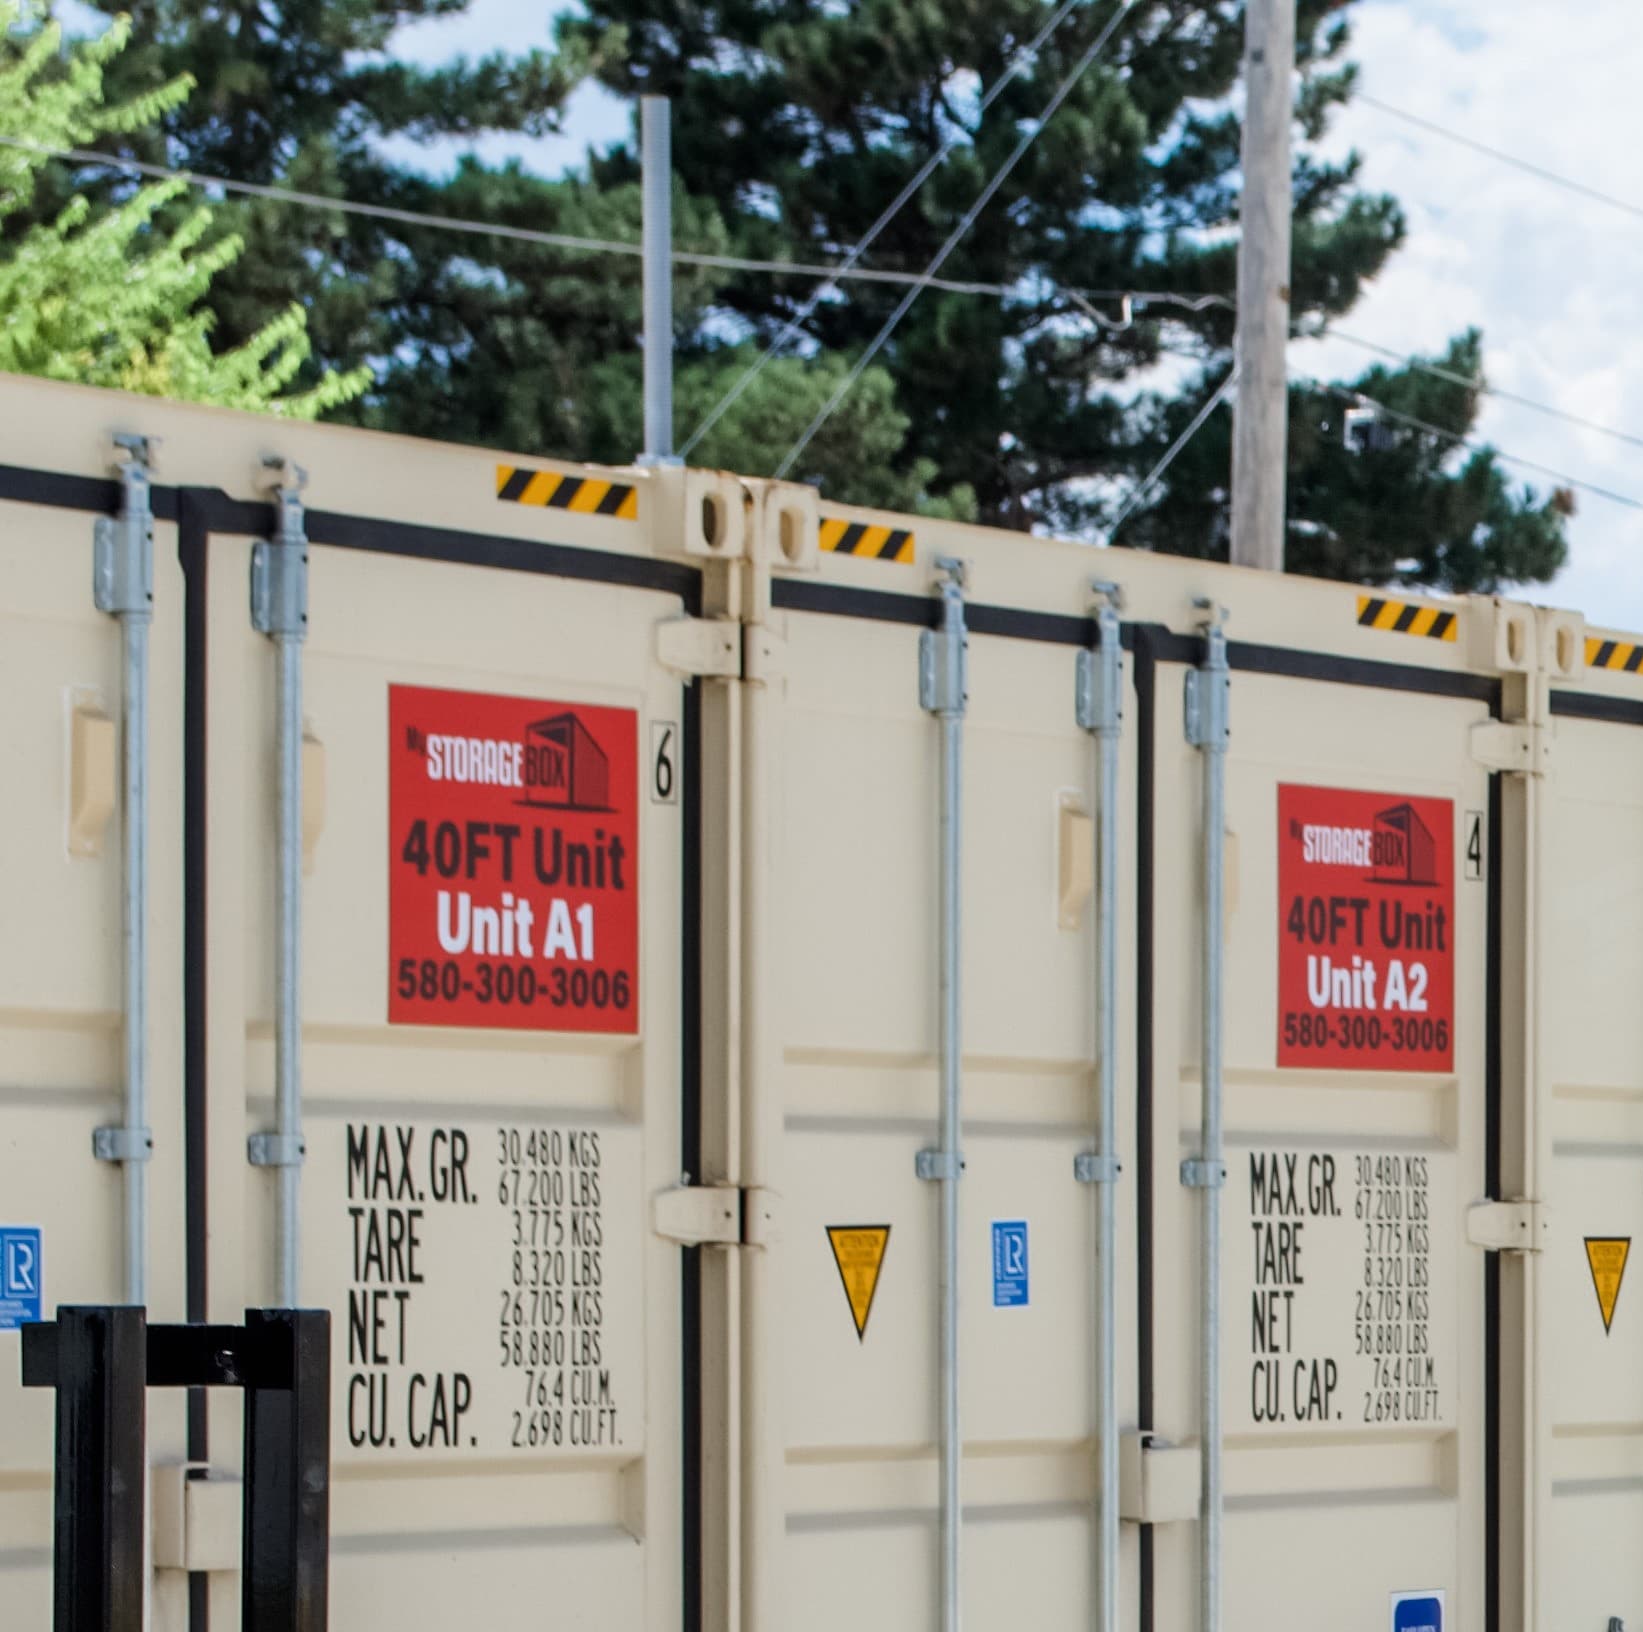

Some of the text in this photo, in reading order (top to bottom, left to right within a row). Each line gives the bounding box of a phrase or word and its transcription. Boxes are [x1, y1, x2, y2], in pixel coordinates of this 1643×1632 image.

[427, 734, 523, 787] STORAGE
[526, 745, 565, 788] BOX
[656, 728, 672, 797] 6
[402, 820, 625, 890] 40FT Unit
[1303, 825, 1372, 866] STORAGE
[1468, 816, 1480, 876] 4
[438, 891, 594, 960] Unit A1
[1288, 896, 1446, 952] 40FT Unit
[398, 959, 630, 1009] 580-300-3006
[1308, 955, 1428, 1012] Unit A2
[1284, 1013, 1448, 1052] 580-300-3006
[498, 1129, 601, 1168] 30.480 KGS
[499, 1170, 601, 1207] 67.200 LBS
[1355, 1155, 1428, 1187] 30.480 KGS
[1355, 1190, 1428, 1221] 67.200 LBS
[348, 1206, 424, 1283] TARE
[513, 1210, 601, 1247] 3.775 KGS
[1365, 1223, 1429, 1254] 3.775 KGS
[513, 1251, 601, 1286] 8.320 LBS
[1252, 1222, 1303, 1285] TARE
[1365, 1257, 1428, 1287] 8.320 LBS
[501, 1290, 602, 1327] 26.705 KGS
[1252, 1291, 1293, 1353] NET
[1356, 1290, 1429, 1321] 26.705 KGS
[349, 1289, 410, 1365] NET
[1355, 1324, 1428, 1354] 58.880 LBS
[501, 1330, 601, 1367] 58.880 LBS
[525, 1370, 564, 1407] 76.4
[1252, 1358, 1341, 1422] CU. CAP.
[1374, 1358, 1401, 1388] 76.4
[349, 1373, 477, 1447] CU. CAP.
[1364, 1391, 1400, 1422] 2.698
[513, 1410, 563, 1447] 2.698
